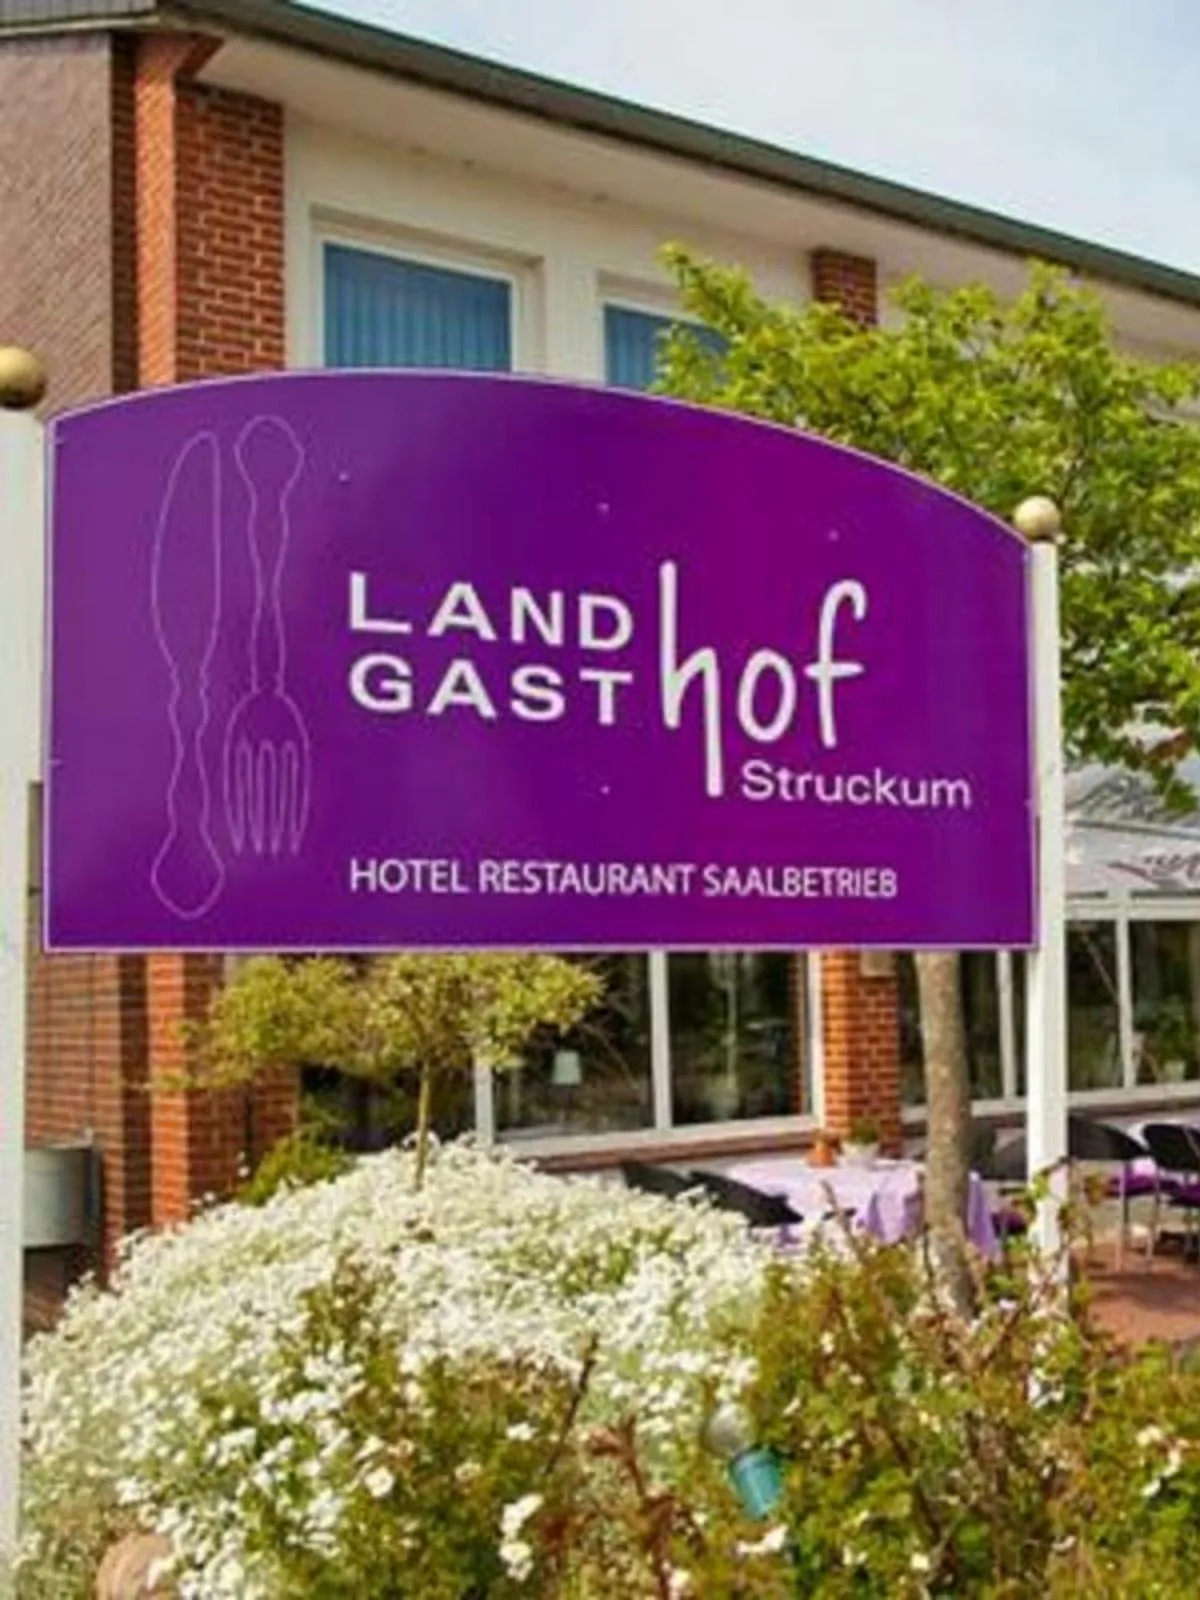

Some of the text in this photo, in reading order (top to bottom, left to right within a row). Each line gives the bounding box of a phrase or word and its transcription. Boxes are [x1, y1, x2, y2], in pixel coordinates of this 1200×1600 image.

[349, 571, 634, 651] LAND
[348, 560, 867, 798] GAST hof
[741, 758, 972, 807] Struckum
[350, 858, 898, 898] HOTEL RESTAURANT SAALBETRIEB
